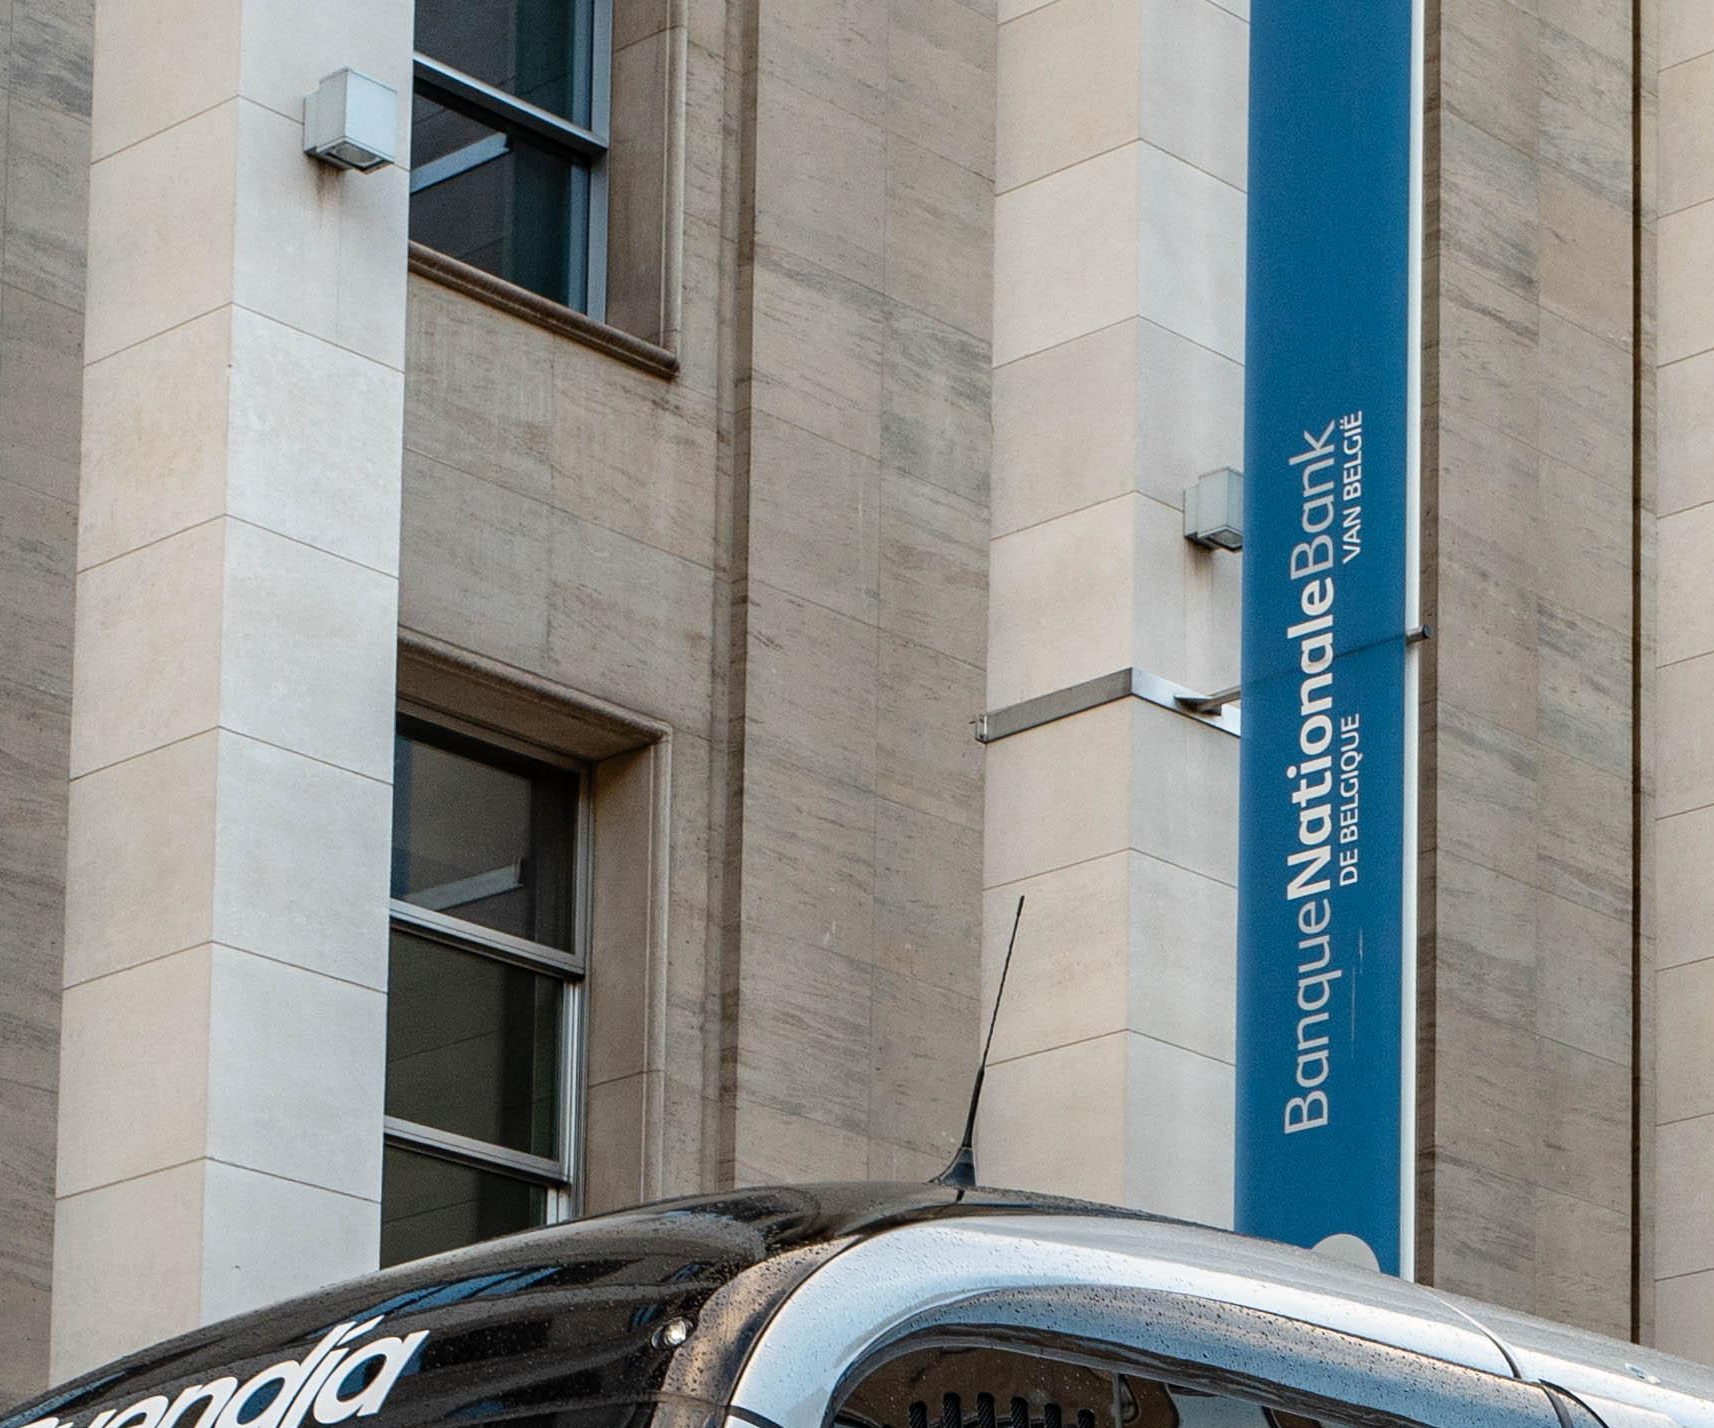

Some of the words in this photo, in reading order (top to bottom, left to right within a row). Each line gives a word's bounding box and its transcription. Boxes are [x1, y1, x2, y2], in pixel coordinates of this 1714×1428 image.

[1339, 410, 1364, 502] BELGIË
[1342, 509, 1362, 565] VAN
[1339, 713, 1361, 841] BELGIQUE
[1339, 848, 1358, 886] DE
